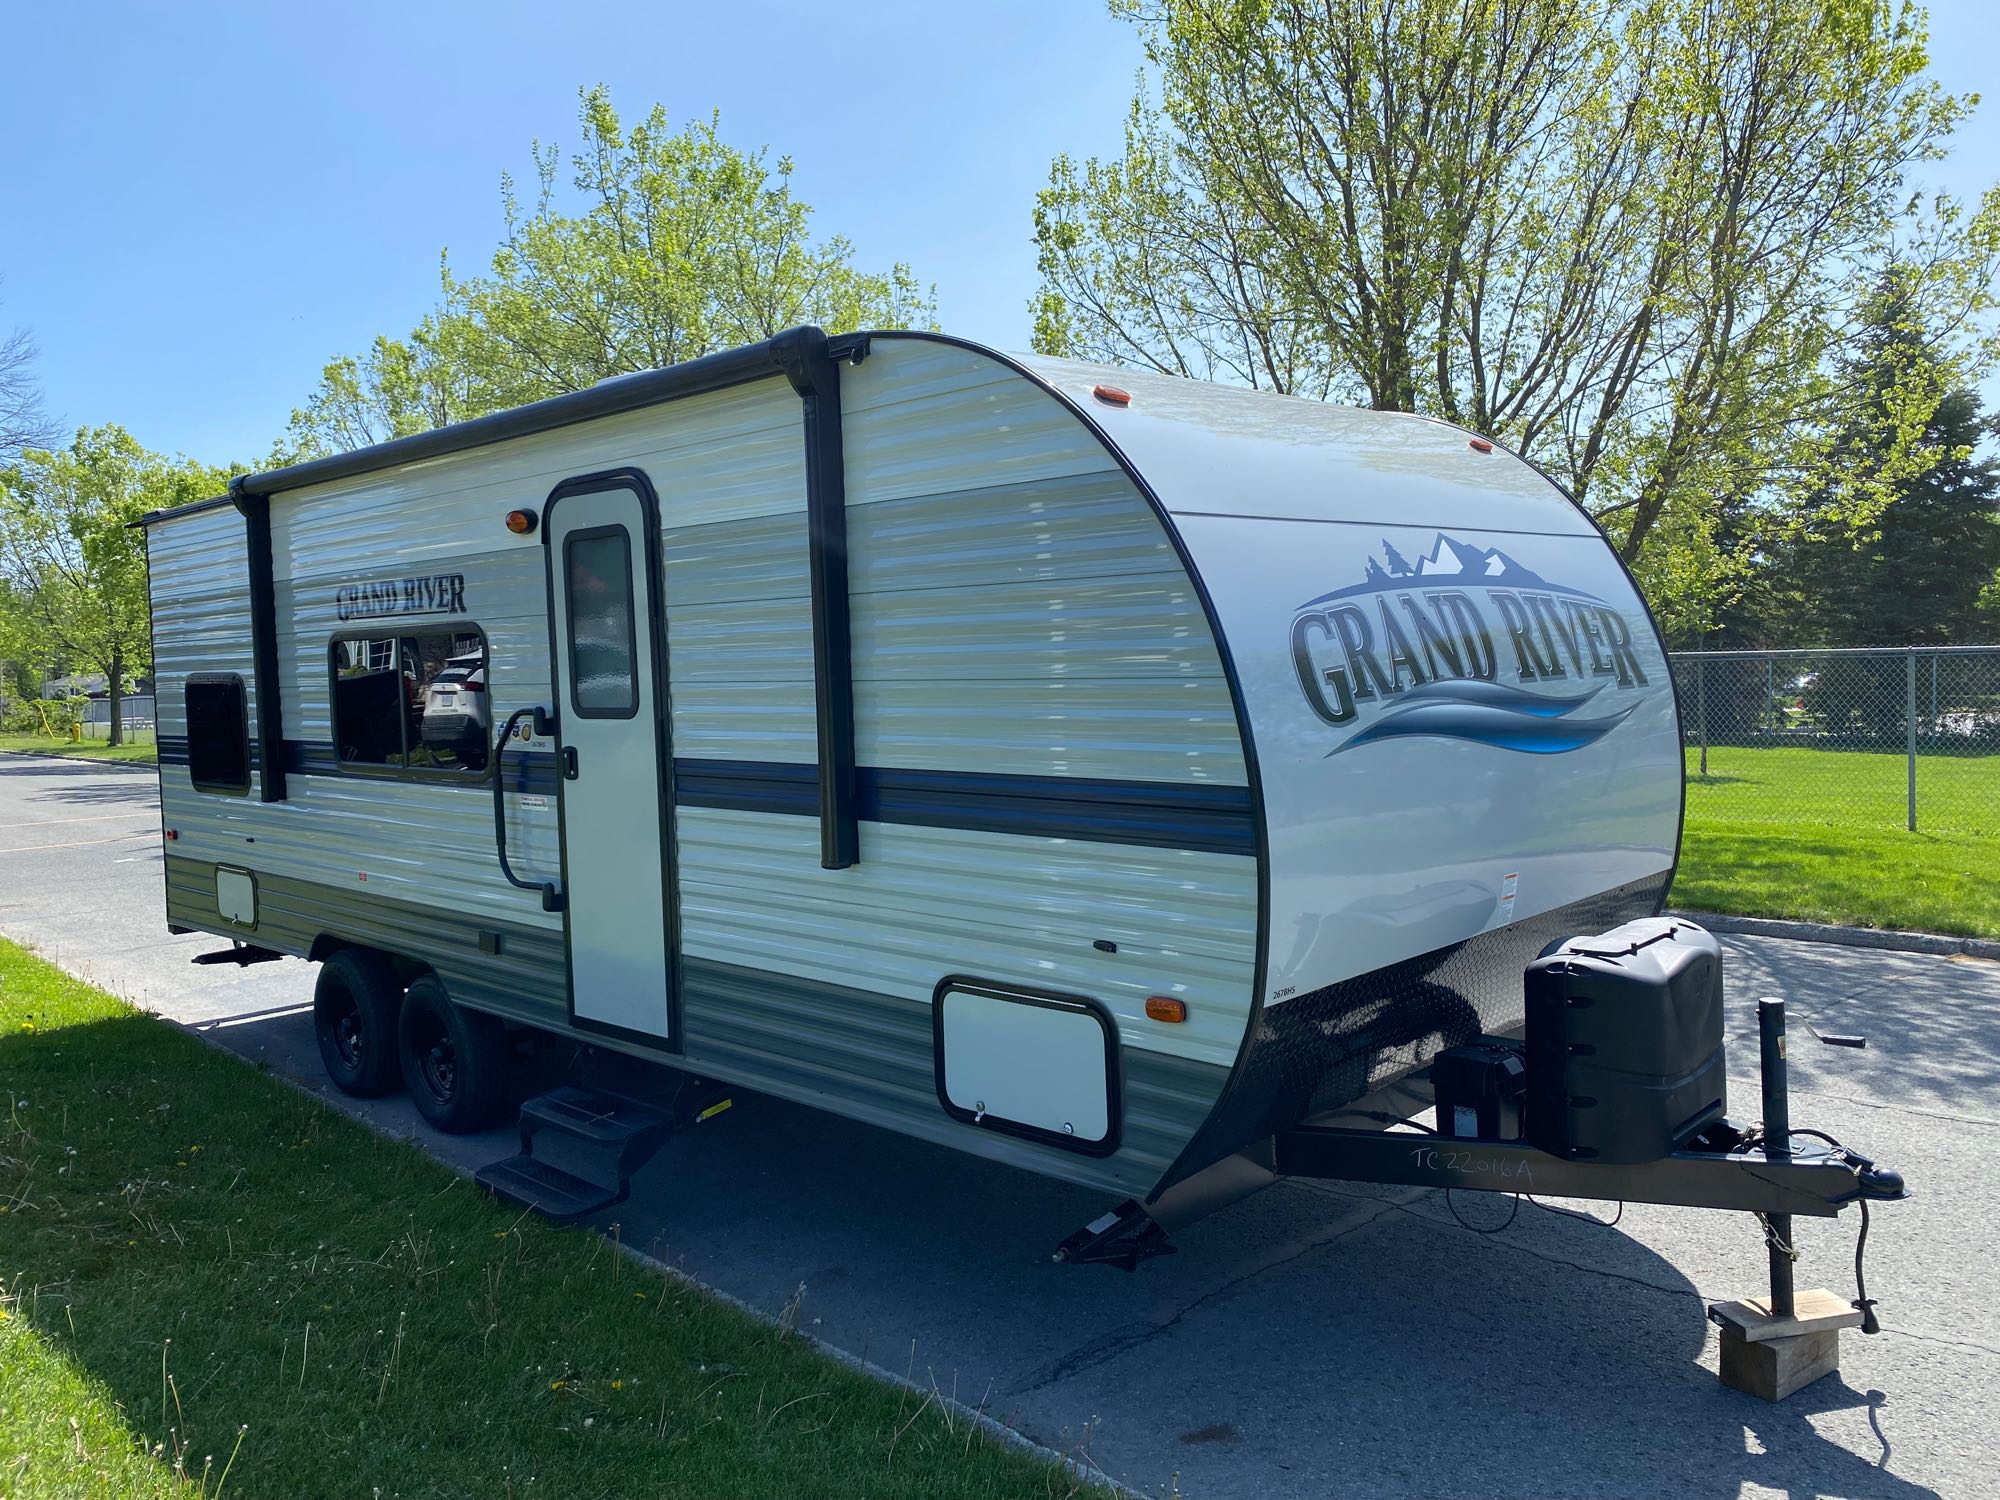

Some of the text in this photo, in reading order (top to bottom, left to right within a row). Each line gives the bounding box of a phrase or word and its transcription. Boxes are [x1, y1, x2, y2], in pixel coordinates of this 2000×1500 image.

[336, 572, 467, 622] GRAND RIVER
[1288, 588, 1650, 728] GRAND RIVER
[1272, 985, 1296, 1000] 267BHS
